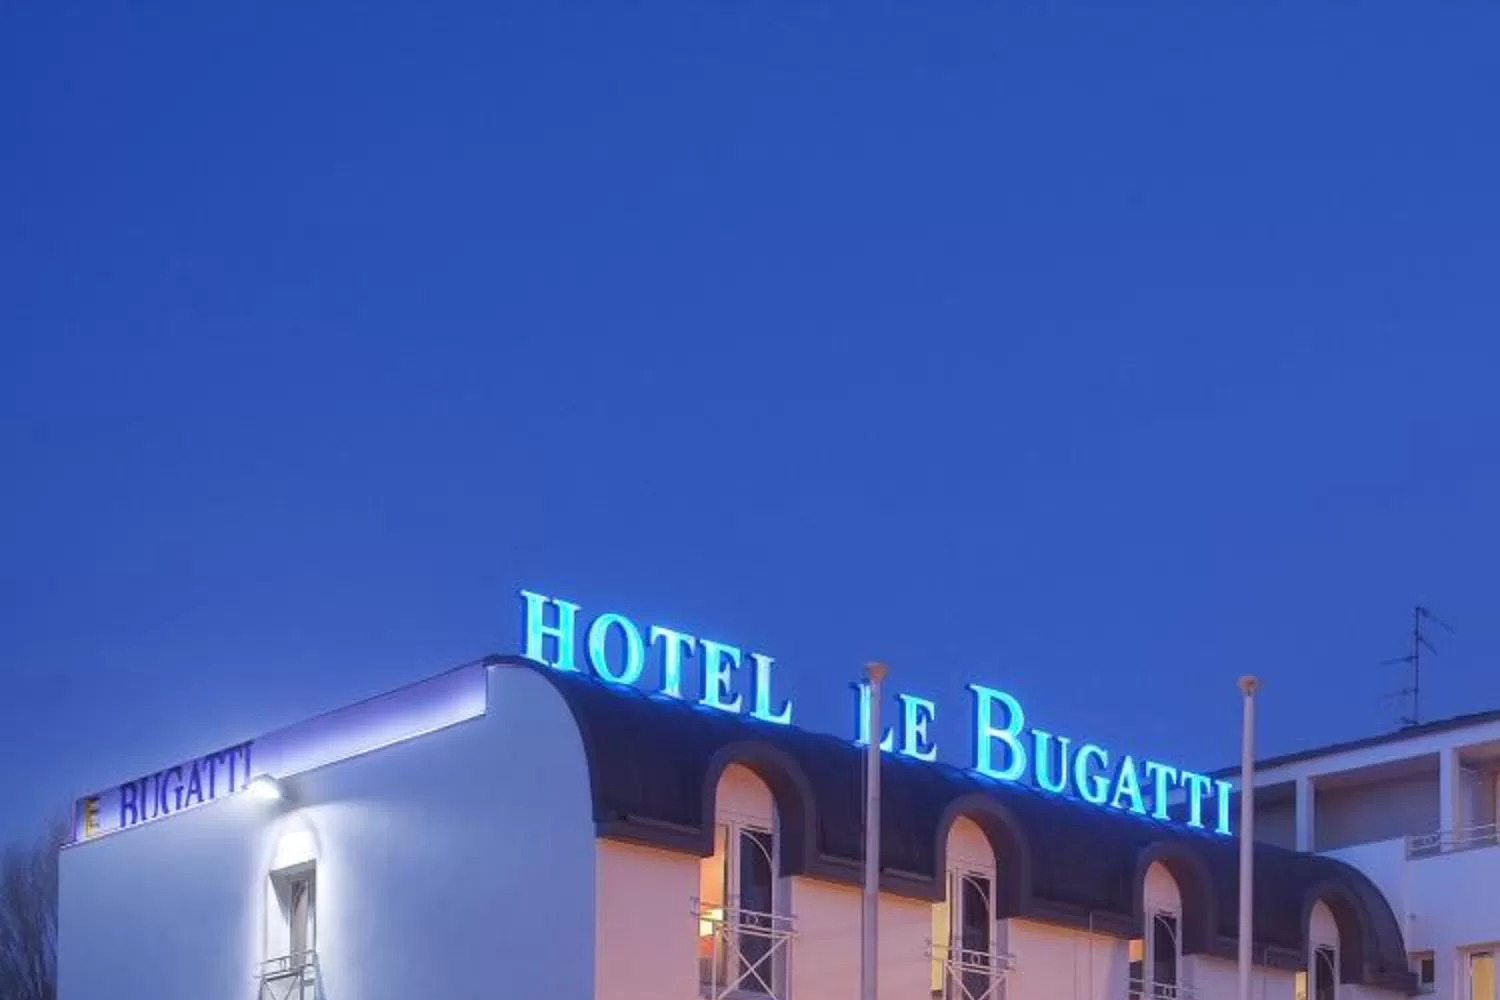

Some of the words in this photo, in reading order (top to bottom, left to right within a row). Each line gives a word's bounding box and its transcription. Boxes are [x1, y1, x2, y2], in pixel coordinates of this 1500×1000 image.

[119, 739, 255, 829] BUGATTI
[519, 588, 794, 726] HOTEL
[849, 682, 938, 763] LE
[966, 683, 1234, 836] BUGATTI
